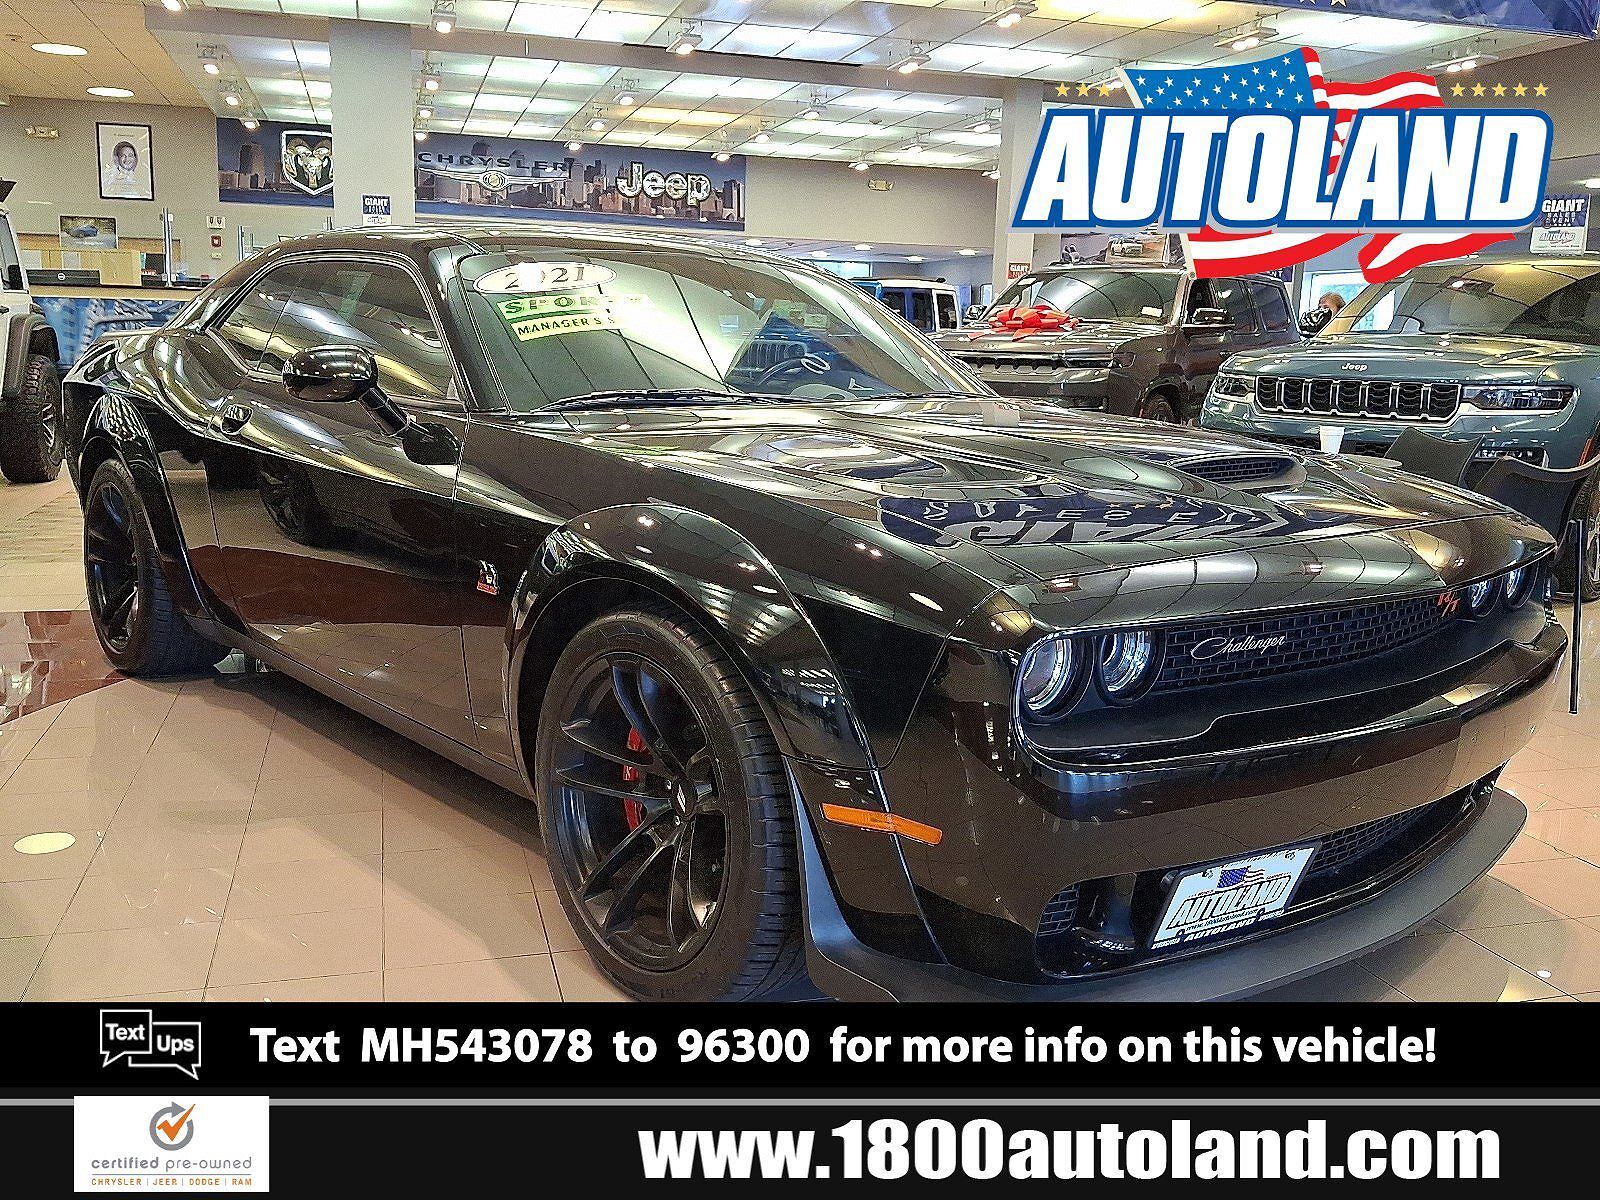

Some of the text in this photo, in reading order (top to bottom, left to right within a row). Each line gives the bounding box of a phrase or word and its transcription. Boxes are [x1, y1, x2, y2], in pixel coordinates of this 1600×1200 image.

[418, 152, 567, 172] CHRYSLER
[616, 161, 712, 206] Jeep
[1542, 199, 1585, 213] GIANT
[504, 266, 586, 290] 221
[517, 316, 603, 336] MANAGERS
[1341, 362, 1368, 372] Jeep
[1190, 635, 1286, 660] Challenger
[1166, 876, 1292, 930] AUTOLAND
